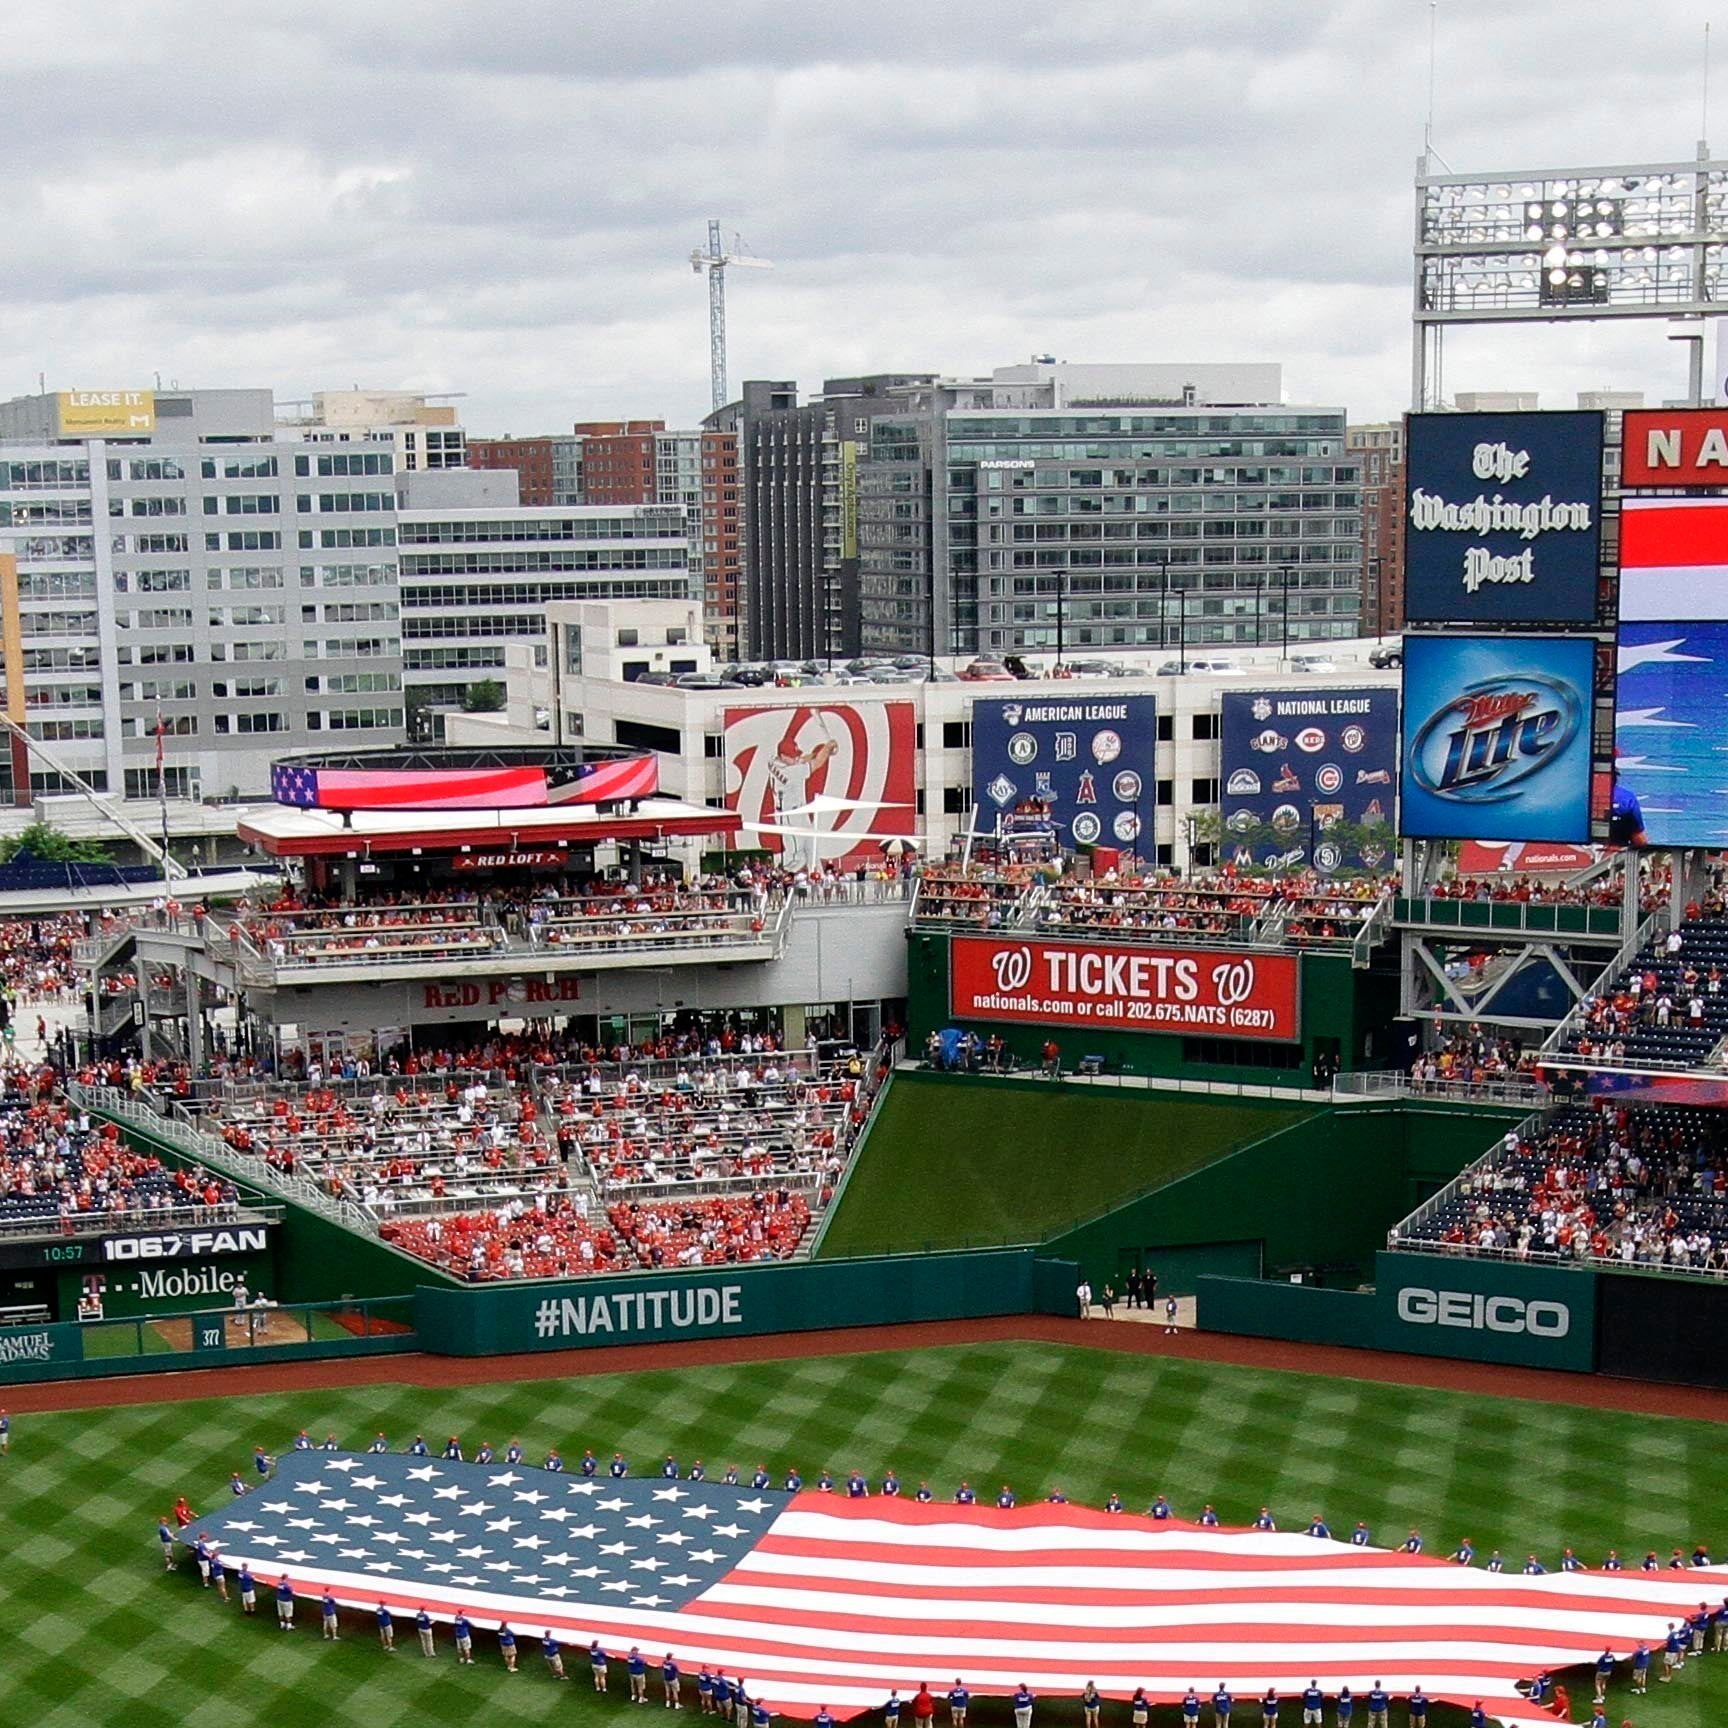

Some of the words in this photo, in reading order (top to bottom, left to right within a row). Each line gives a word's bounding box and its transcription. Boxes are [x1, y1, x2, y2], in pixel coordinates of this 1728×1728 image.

[70, 393, 121, 406] LEASE
[124, 393, 143, 405] IT.
[980, 460, 1035, 469] PARSONS
[1472, 442, 1531, 480] The
[1410, 487, 1592, 538] Washington
[1462, 546, 1535, 592] Post
[1024, 706, 1083, 722] AMERICAN
[1085, 705, 1128, 720] LEAGUE
[1277, 701, 1328, 715] NATIONAL
[1330, 699, 1371, 713] LEAGUE
[1435, 709, 1562, 792] Lite
[477, 854, 505, 868] RED
[508, 853, 544, 866] LOFT
[1524, 853, 1577, 865] nationals.com
[1043, 950, 1199, 1001] TICKETS
[424, 983, 480, 1008] RED
[973, 993, 1073, 1014] nationals.com
[1077, 1003, 1093, 1016] or
[1096, 1000, 1124, 1018] call
[1127, 1001, 1226, 1024] 202.675.NATS
[1229, 1009, 1275, 1030] (6287)
[44, 1245, 83, 1261] 10:57
[191, 1230, 267, 1254] FAN
[535, 1285, 742, 1338] #NATITUDE
[1396, 1286, 1570, 1338] GEICO
[202, 1328, 220, 1347] 377
